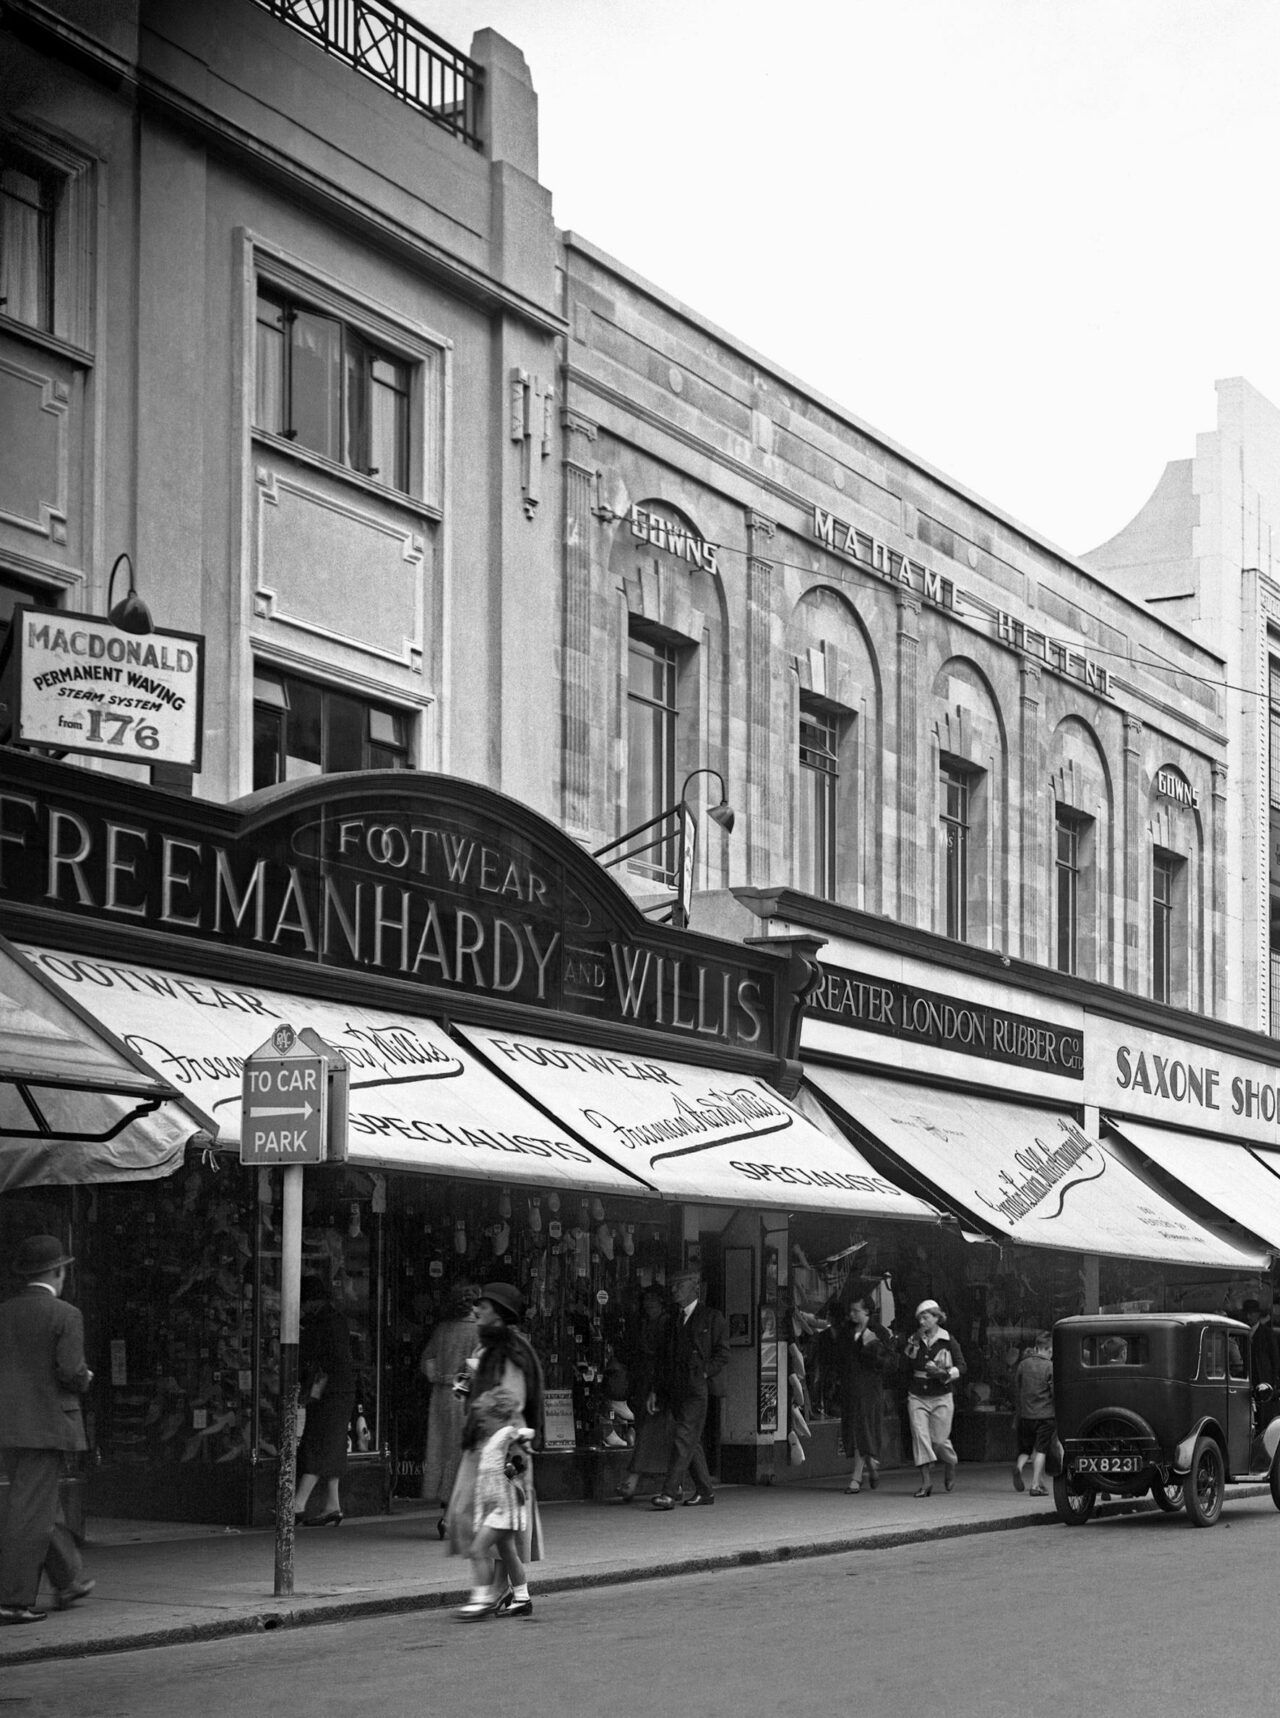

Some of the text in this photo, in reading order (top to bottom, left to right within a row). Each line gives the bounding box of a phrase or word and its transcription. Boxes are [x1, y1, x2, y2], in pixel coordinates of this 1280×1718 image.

[631, 504, 720, 576] GOWNS
[813, 505, 965, 617] MADAME
[27, 621, 194, 674] MACDONALD
[33, 665, 187, 711] PERMANENT WAVING
[57, 687, 164, 712] STEAM SYSTEM
[58, 716, 84, 731] from
[1158, 770, 1200, 811] GOWNS
[338, 818, 550, 907] FOOTWEAR
[562, 957, 607, 989] AND
[608, 939, 762, 1043] WILLIS
[902, 994, 986, 1047] LONDON
[992, 1018, 1057, 1065] RUBBER
[249, 1069, 317, 1092] TO CAR
[488, 1038, 683, 1087] FOOTWEAR
[1116, 1045, 1220, 1111] SAXONE
[254, 1130, 308, 1153] PARK
[348, 1112, 592, 1164] SPECIALISTS
[728, 1160, 902, 1196] SPECIALISTS
